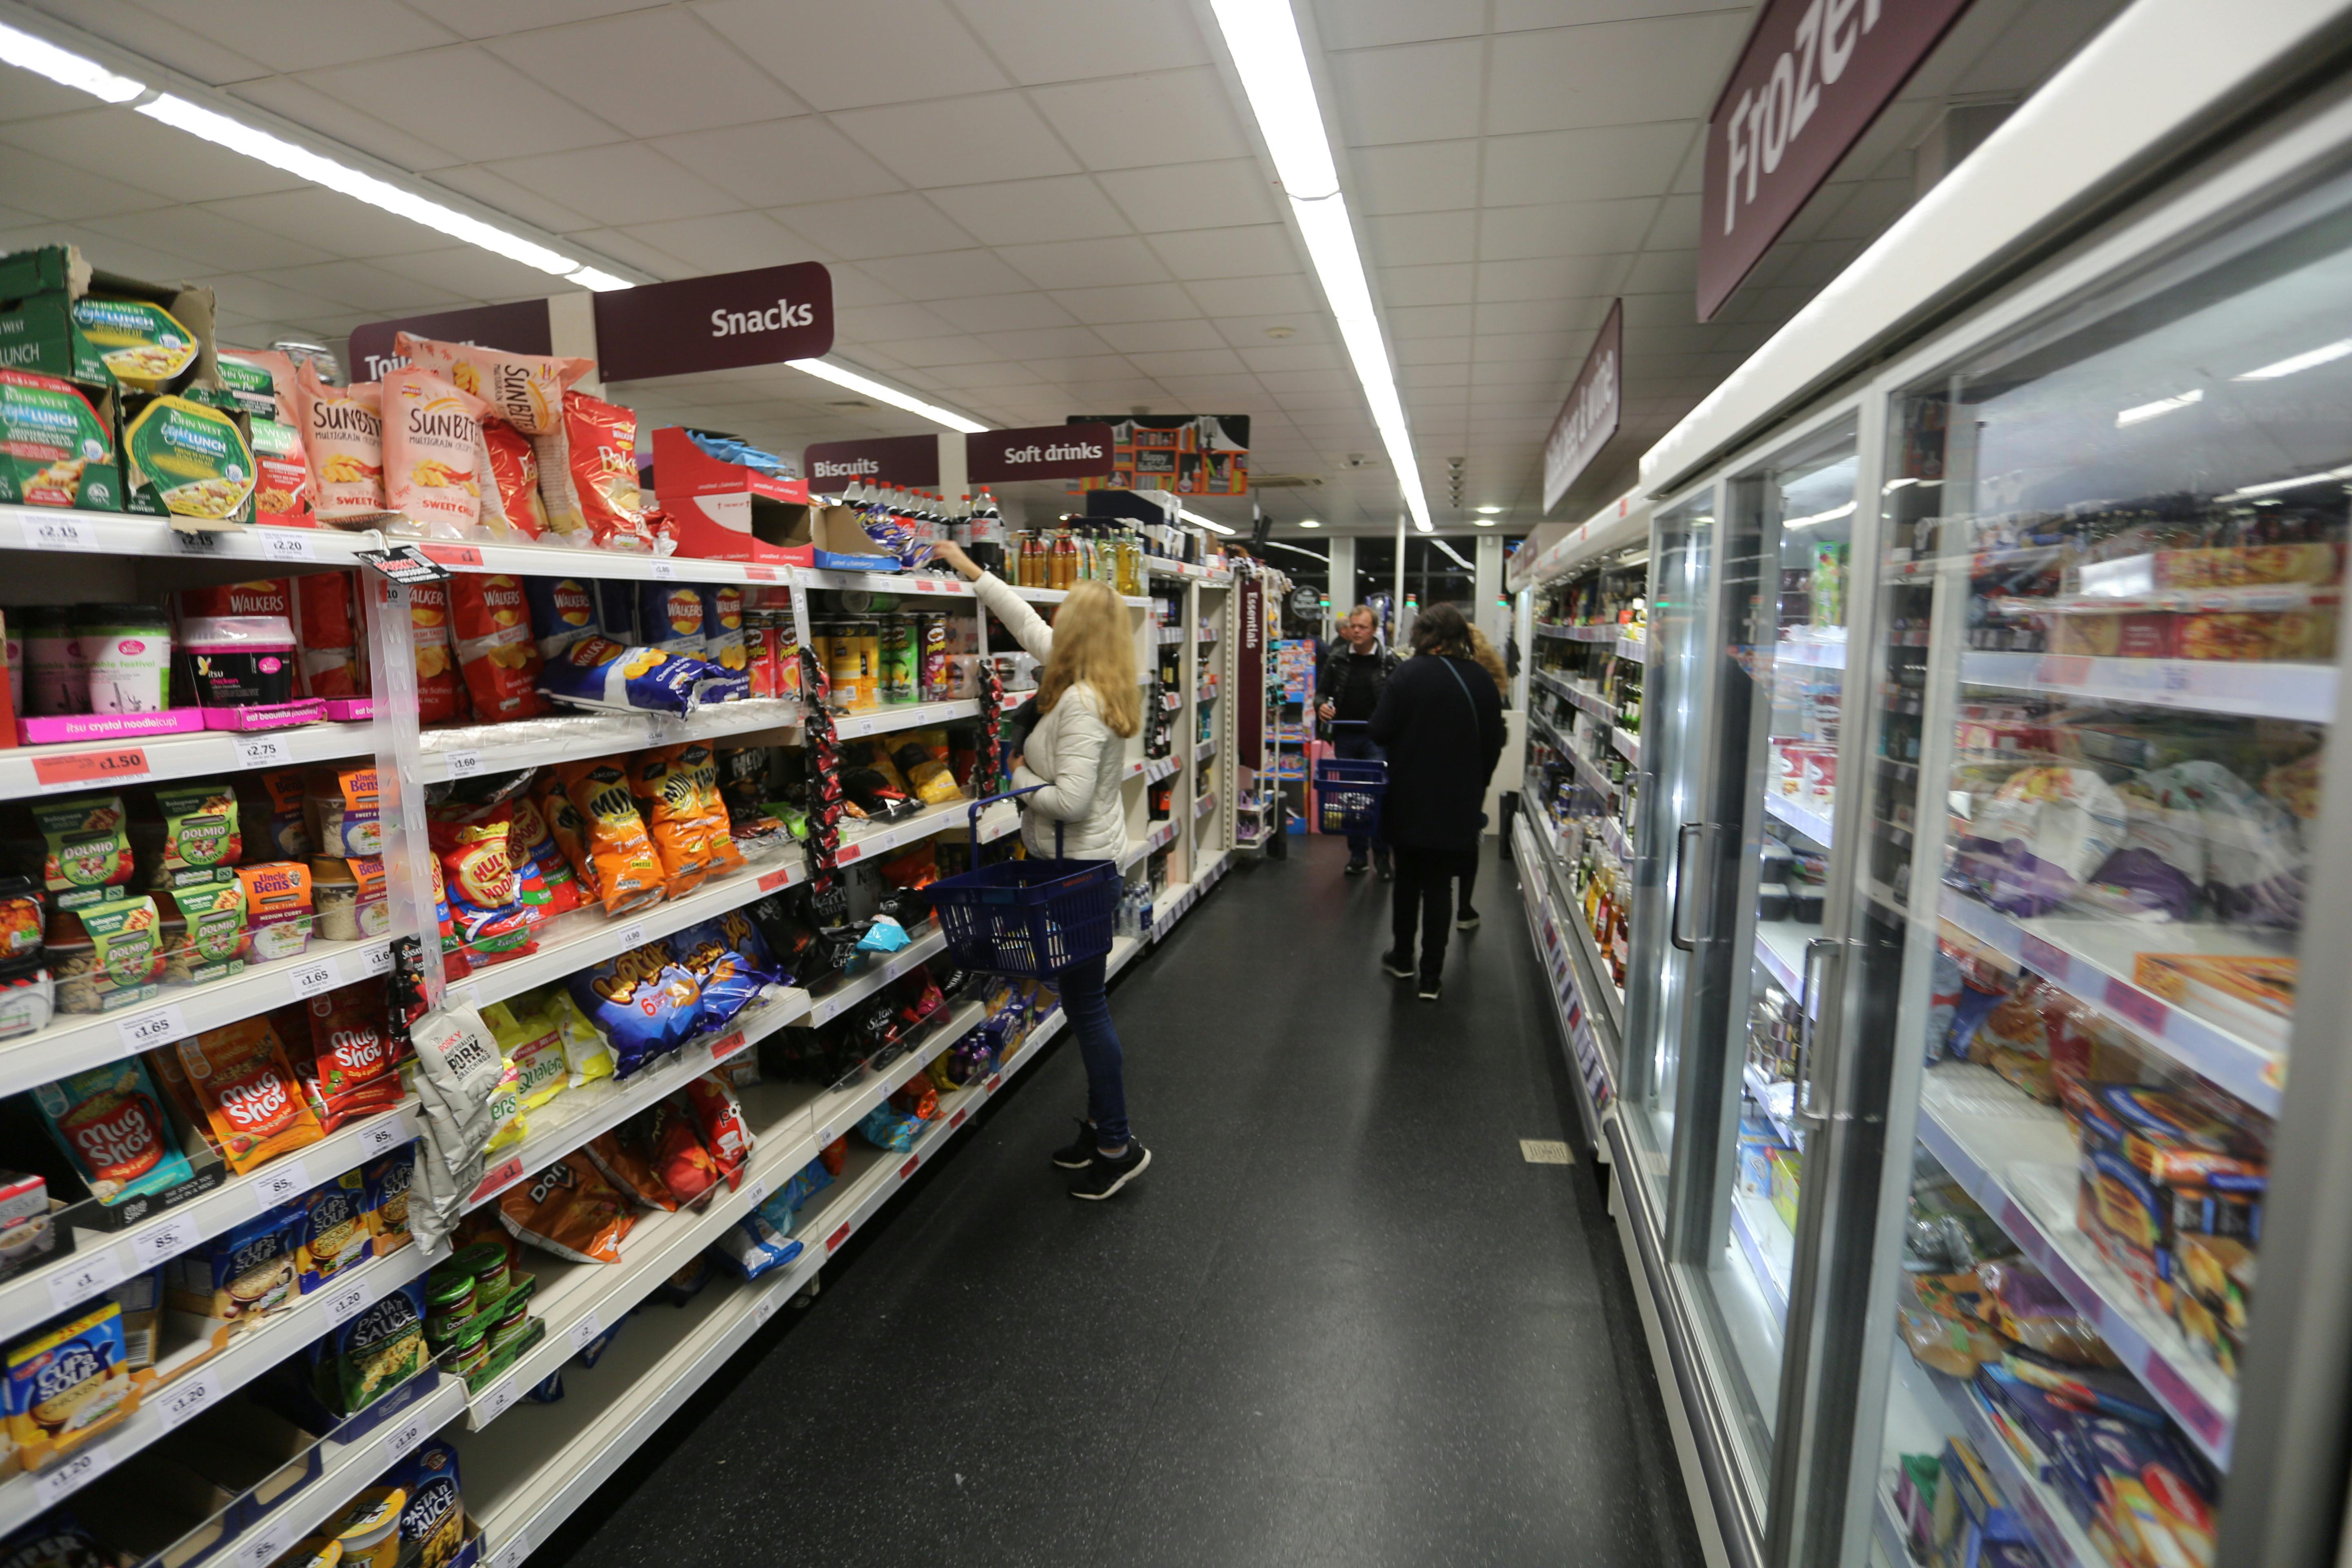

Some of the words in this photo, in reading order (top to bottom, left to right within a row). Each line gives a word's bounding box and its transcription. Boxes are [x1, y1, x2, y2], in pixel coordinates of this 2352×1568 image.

[1724, 0, 1884, 235] Froze
[107, 313, 154, 327] LUNCH
[710, 298, 814, 339] Snacks
[238, 371, 259, 384] WEST
[5, 385, 37, 404] JOHN
[39, 394, 69, 410] WEST
[31, 410, 78, 427] LUNCH
[170, 410, 196, 428] JOHN
[198, 421, 223, 436] WEST
[313, 402, 382, 438] SUNBIT
[409, 408, 481, 448] SUNBITE
[189, 434, 226, 452] LUNCH
[315, 431, 361, 443] MULTIGRAIN
[409, 435, 452, 449] MULTIGRAIN
[612, 430, 635, 441] WALKER
[597, 445, 637, 475] Bake
[1004, 446, 1041, 464] Soft
[1044, 441, 1103, 462] drinks
[813, 458, 879, 478] Biscuits
[336, 497, 372, 507] SWEET
[422, 499, 457, 513] SWEET
[38, 526, 78, 538] £2.15
[273, 540, 302, 551] £2.20
[230, 595, 284, 613] WALKERS
[483, 589, 520, 607] WALKERS
[553, 592, 590, 609] WALKERS
[716, 599, 740, 614] WALKER
[667, 602, 703, 617] WALKERS
[1245, 591, 1258, 649] Essentials
[66, 722, 87, 733] itsu
[89, 719, 122, 733] crystal
[246, 714, 258, 723] eat
[247, 744, 276, 757] £2.75
[99, 753, 141, 770] £1.50
[454, 758, 475, 768] £1.60
[181, 826, 225, 841] DOLMIO
[64, 842, 114, 860] DOLMIO
[259, 872, 286, 883] Uncle
[1062, 873, 1093, 887] Sainsbury's
[260, 913, 283, 922] MEDIUM
[624, 931, 640, 942] £1.90
[108, 942, 150, 961] DOLMIO
[301, 970, 329, 986] £1.65
[640, 997, 657, 1017] 6
[134, 1019, 170, 1039] £1.65
[330, 1027, 379, 1049] Mug
[438, 1030, 462, 1053] PORKY
[454, 1033, 476, 1052] QUALITY
[335, 1045, 382, 1069] Shot
[447, 1039, 485, 1075] PORK
[457, 1054, 491, 1082] SCRATCHINGS
[517, 1056, 564, 1095] Quavers
[220, 1071, 281, 1107] Mug
[229, 1091, 287, 1124] Shot
[77, 1107, 147, 1149] Mug
[89, 1128, 153, 1167] Shot
[503, 1164, 516, 1180] £1
[314, 1207, 349, 1234] SOUP
[235, 1245, 277, 1274] SOUP
[336, 1292, 360, 1313] £1.20
[358, 1299, 395, 1332] PASTA
[354, 1309, 413, 1347] SAUCE
[38, 1361, 100, 1401] SOUP
[172, 1385, 205, 1413] £1.20
[496, 1394, 504, 1406] £2
[396, 1427, 418, 1450] £1.10
[51, 1456, 92, 1487] £1.20
